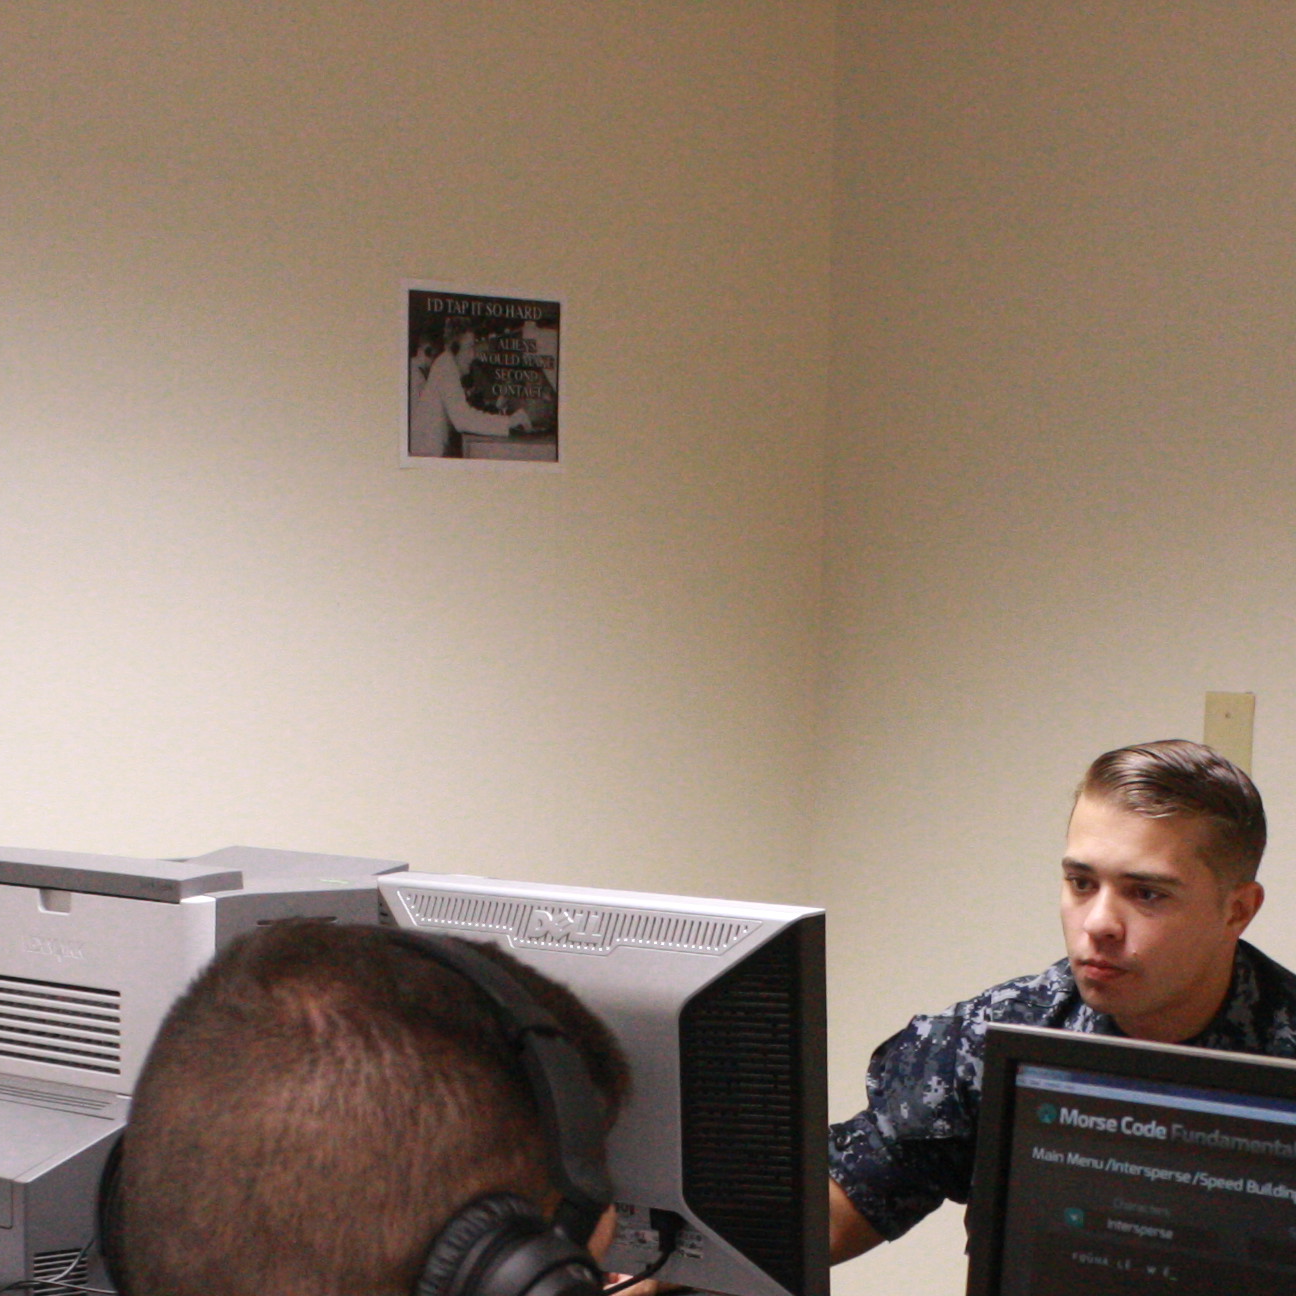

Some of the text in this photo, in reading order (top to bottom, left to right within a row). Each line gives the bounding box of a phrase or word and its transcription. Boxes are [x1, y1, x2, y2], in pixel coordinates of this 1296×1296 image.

[445, 299, 469, 315] TAP
[471, 302, 483, 316] IT
[486, 303, 503, 318] SO
[505, 304, 543, 320] HARD
[479, 353, 520, 367] WOULD
[495, 368, 538, 381] SECOND
[491, 384, 543, 398] CONTACT
[527, 909, 602, 945] DELL
[1059, 1107, 1117, 1134] Morse
[1120, 1116, 1167, 1140] Code
[1032, 1146, 1065, 1164] Main
[1066, 1151, 1104, 1171] Menu
[1106, 1217, 1175, 1240] Intersperse
